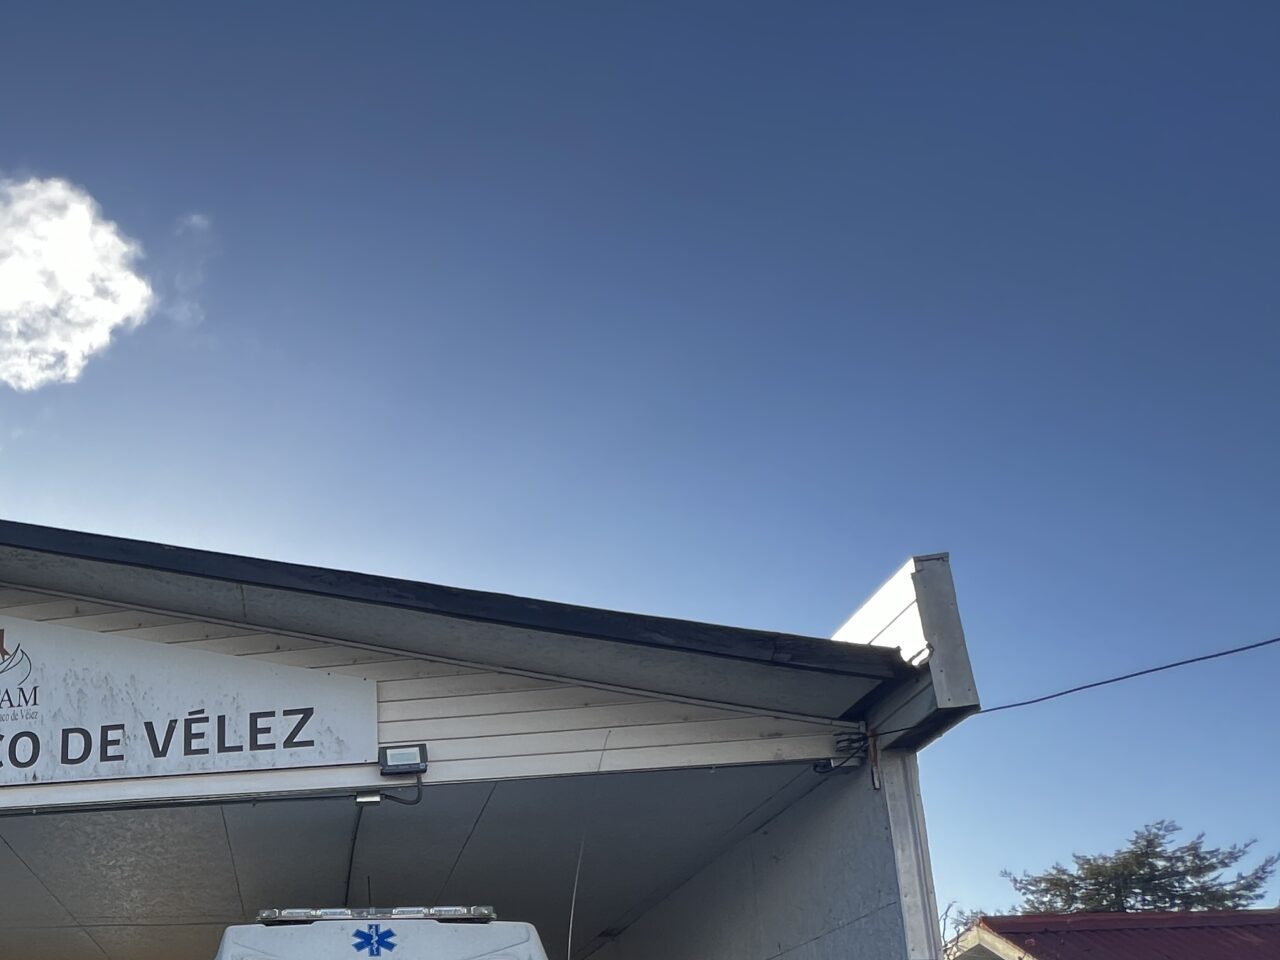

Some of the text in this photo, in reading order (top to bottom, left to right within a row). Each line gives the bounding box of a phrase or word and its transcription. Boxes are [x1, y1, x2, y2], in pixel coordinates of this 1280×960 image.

[10, 711, 19, 721] de
[60, 723, 125, 765] DE
[143, 707, 315, 759] VÉLEZ
